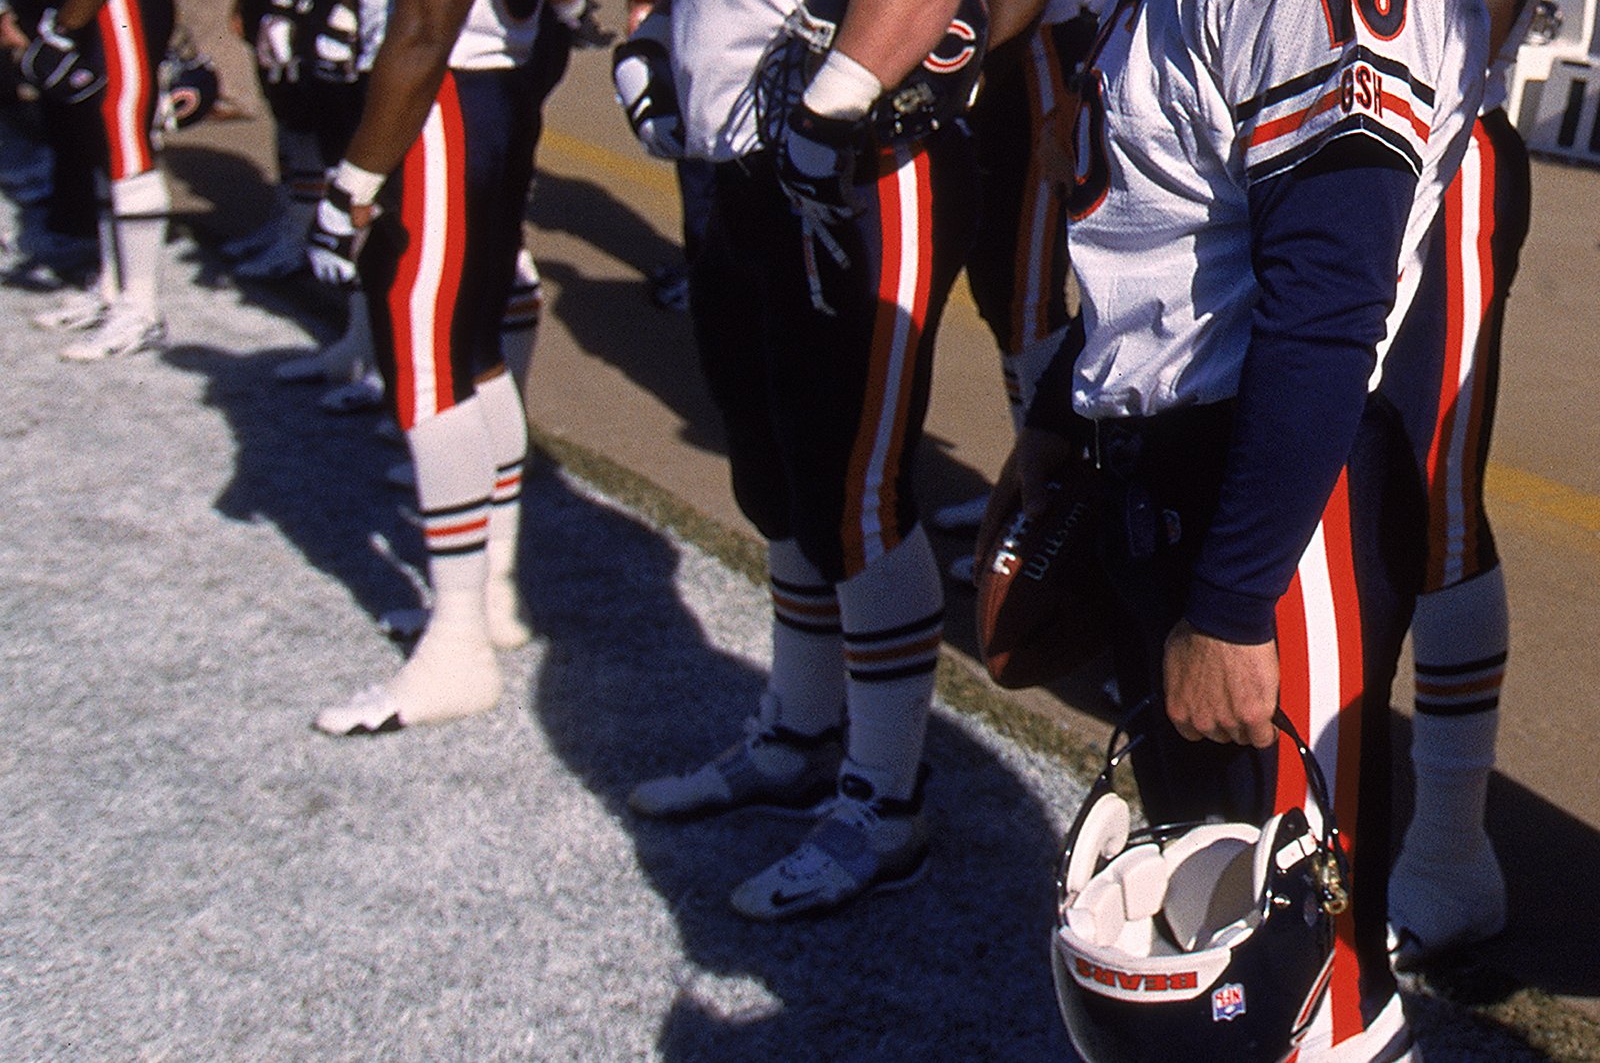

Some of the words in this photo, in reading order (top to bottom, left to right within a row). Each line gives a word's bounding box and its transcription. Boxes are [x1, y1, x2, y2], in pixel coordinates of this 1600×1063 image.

[1340, 64, 1384, 120] GSH
[1023, 501, 1088, 582] Wilson
[1074, 956, 1199, 992] BEARS
